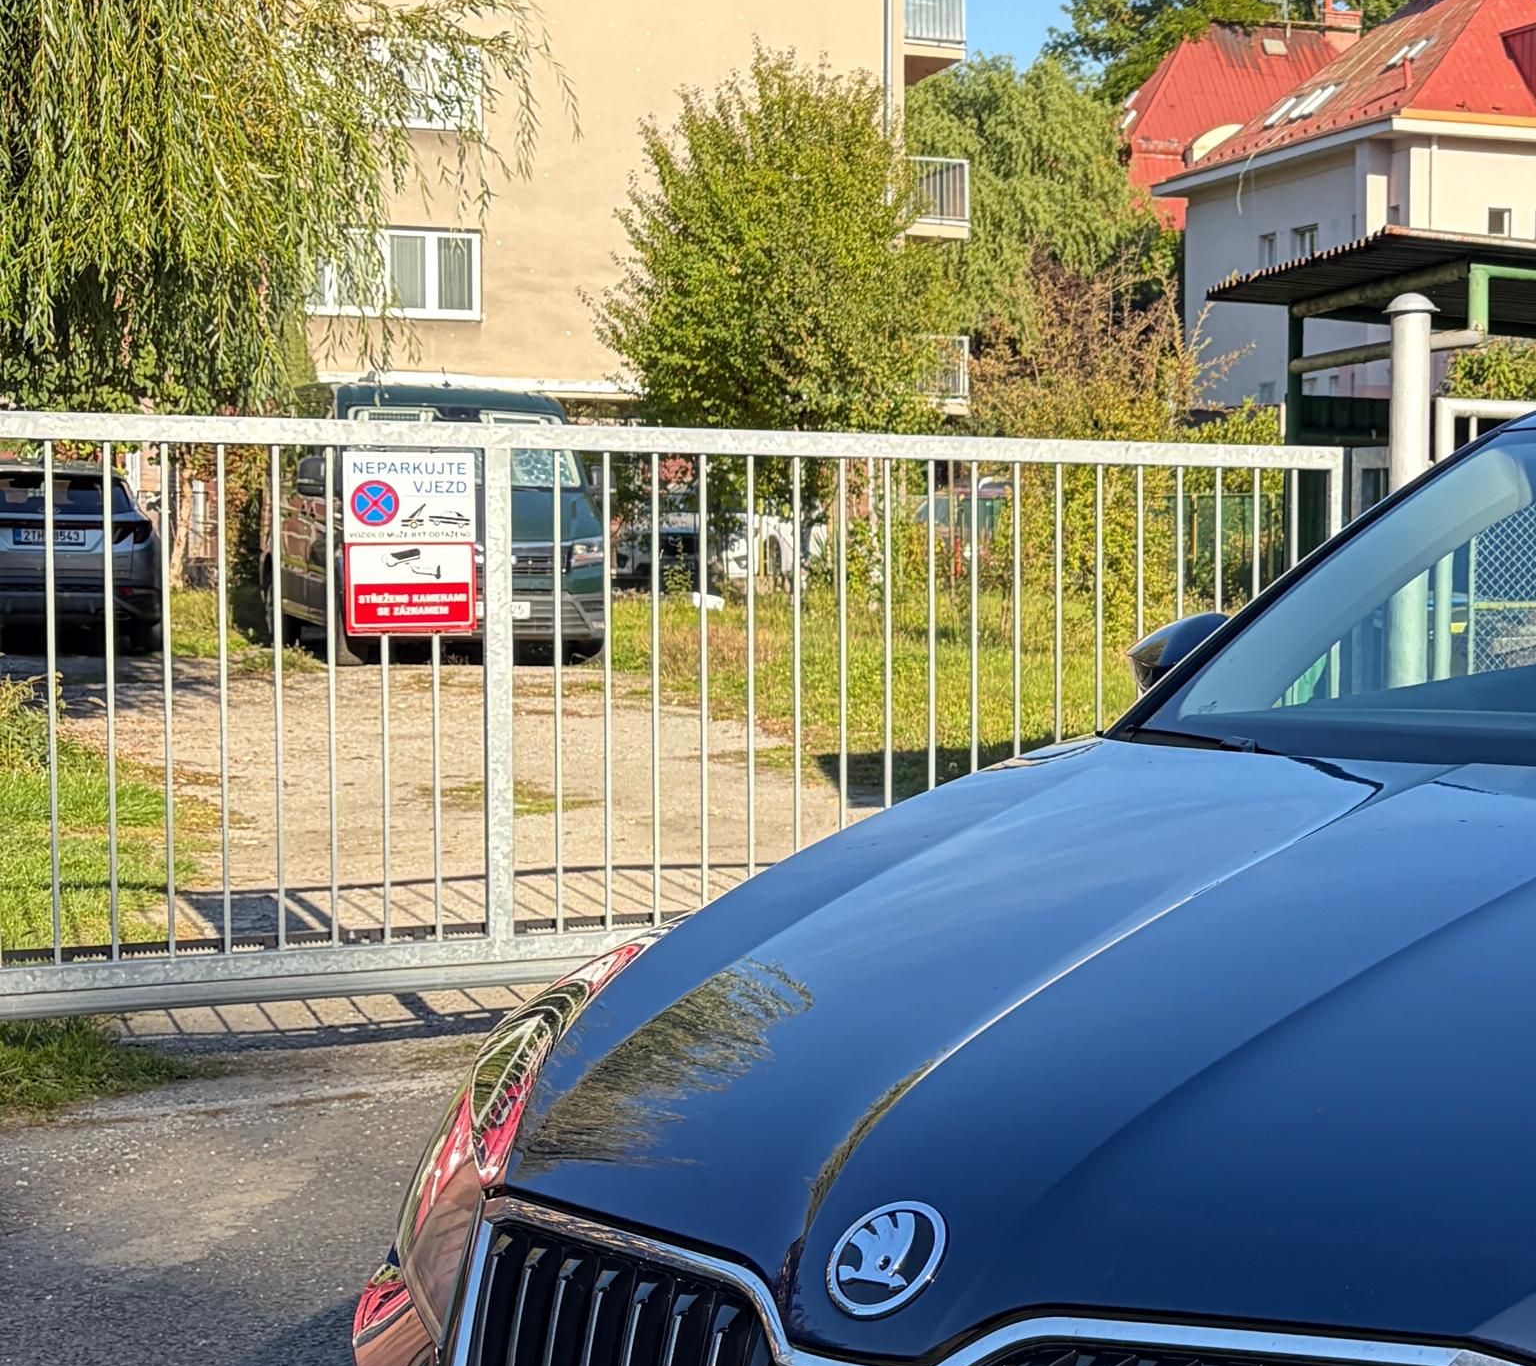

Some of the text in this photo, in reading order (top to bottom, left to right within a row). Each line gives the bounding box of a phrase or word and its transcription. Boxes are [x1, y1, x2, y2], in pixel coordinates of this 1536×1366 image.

[352, 461, 468, 475] NEPARKUJTE
[412, 480, 468, 494] VJEZD
[411, 593, 468, 604] KAMERAMI
[376, 606, 391, 616] SE
